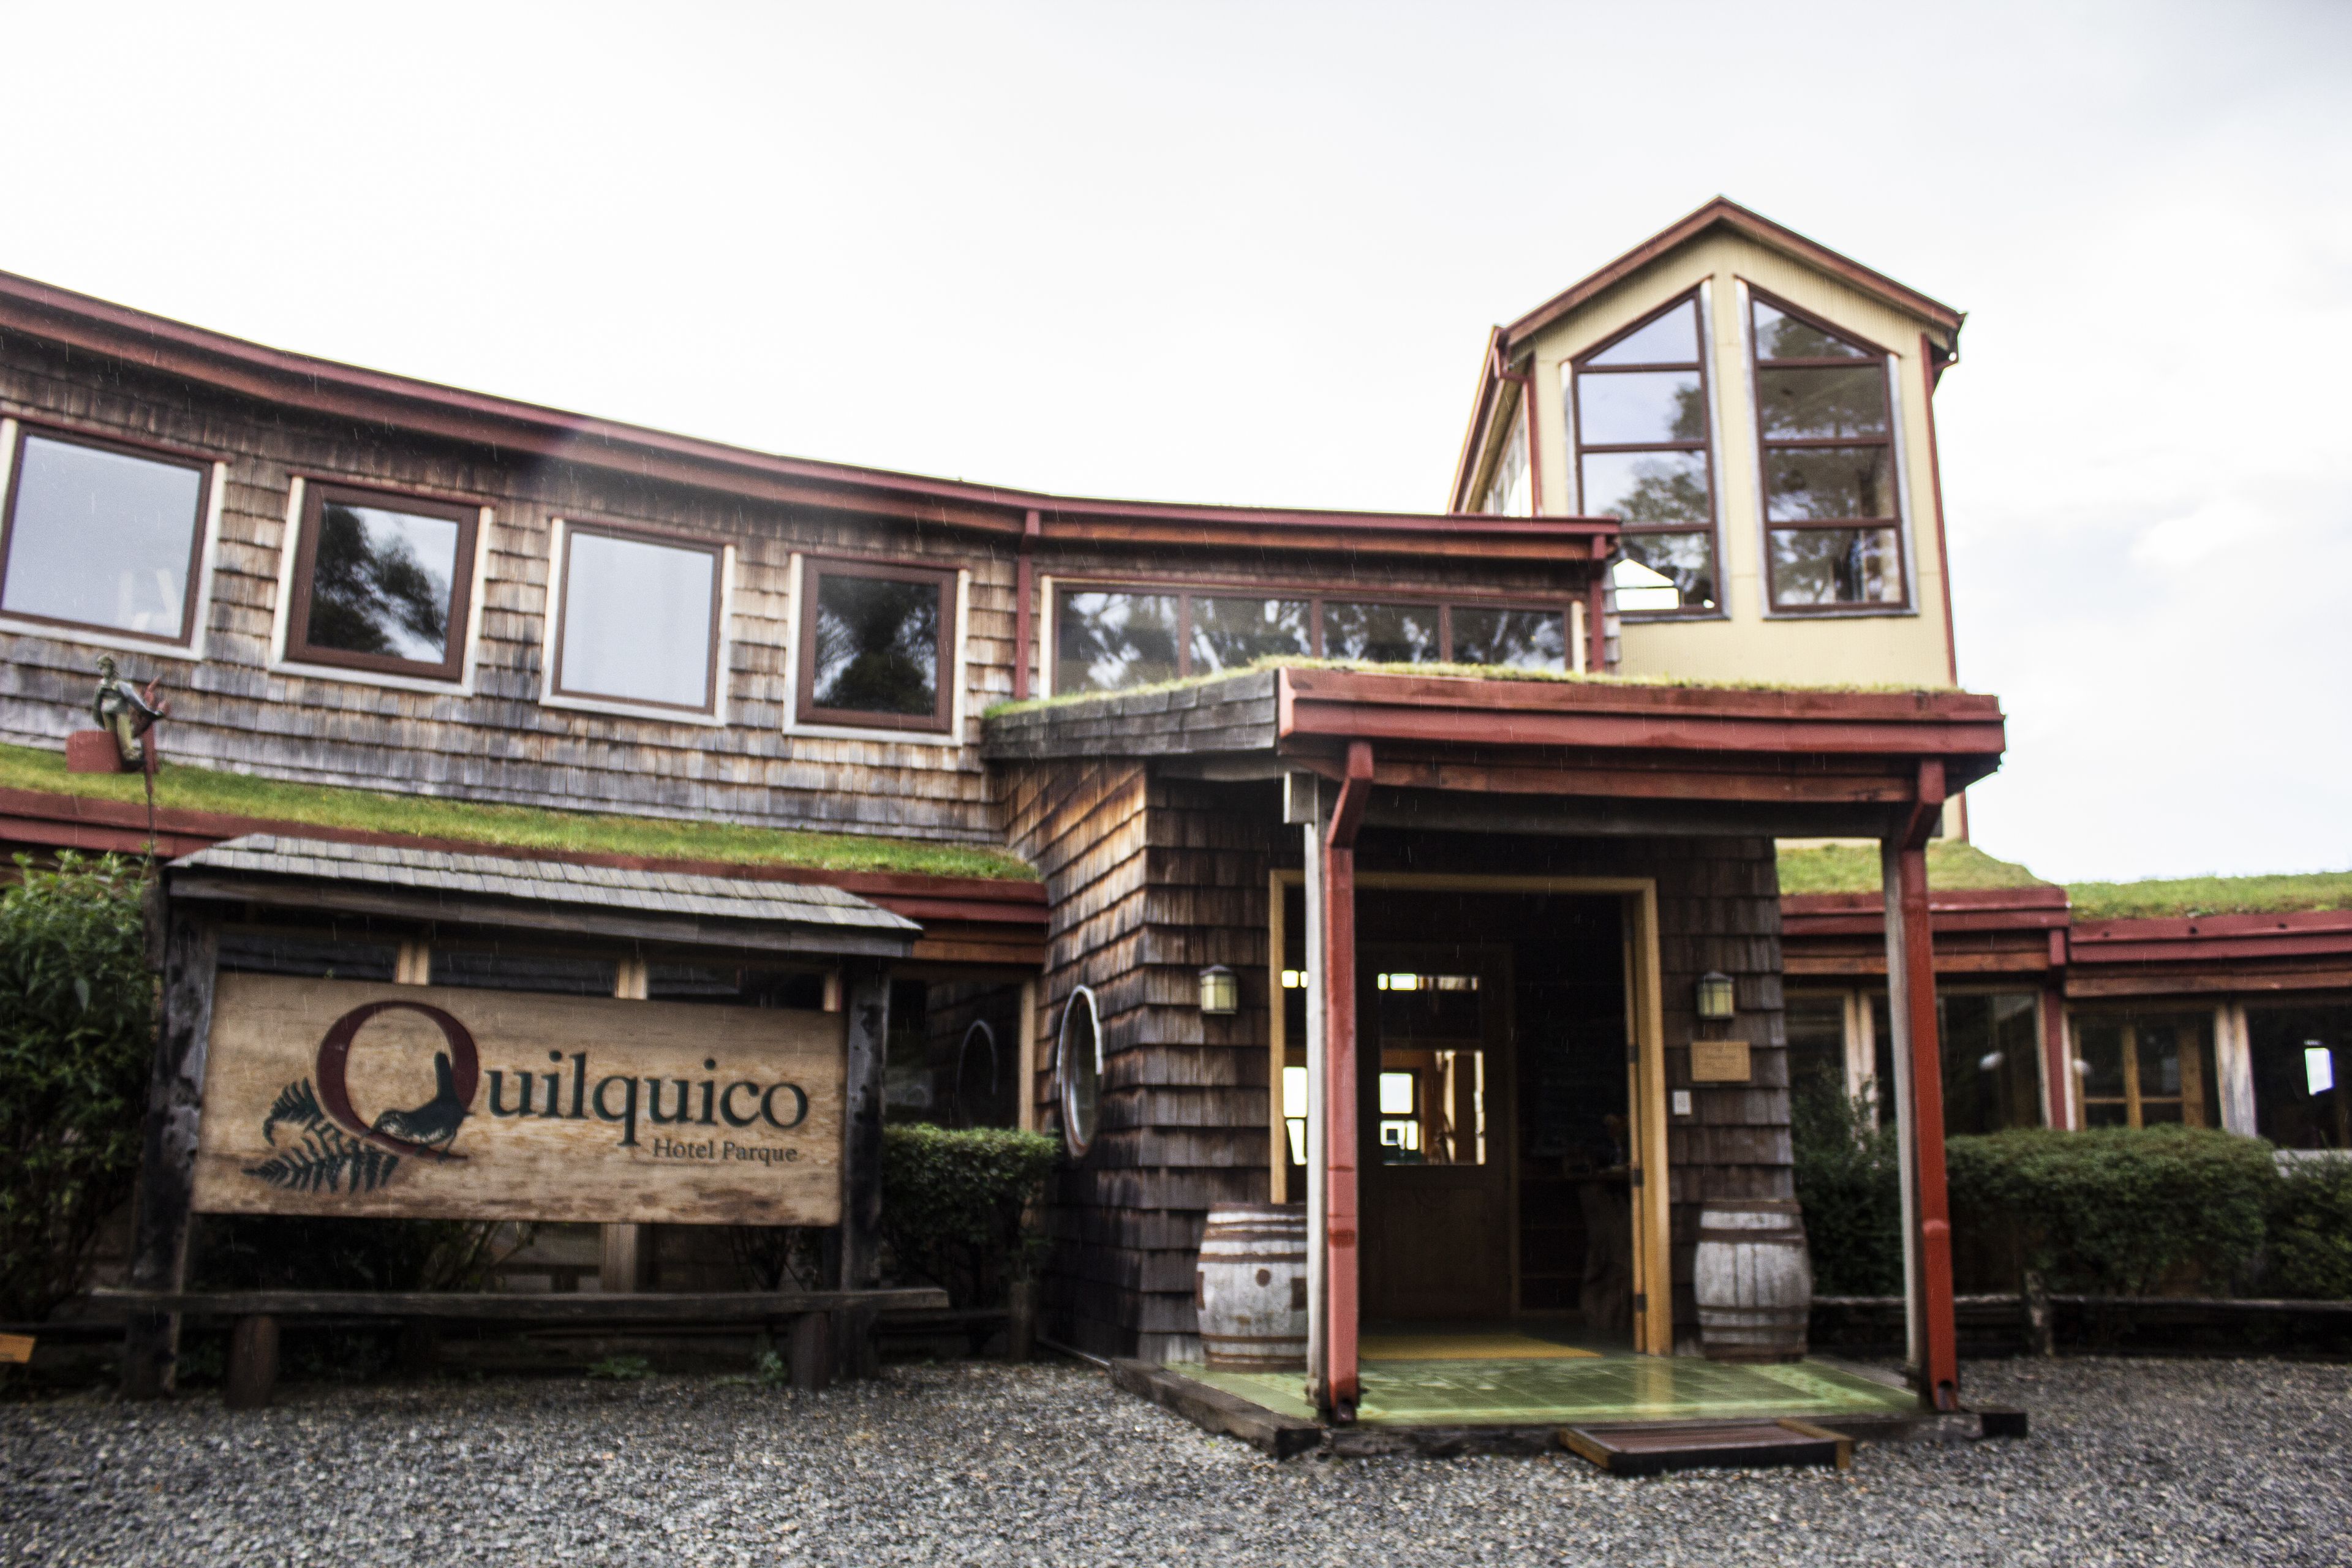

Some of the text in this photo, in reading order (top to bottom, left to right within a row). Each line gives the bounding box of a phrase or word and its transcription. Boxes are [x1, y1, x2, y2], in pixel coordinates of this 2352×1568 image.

[315, 1000, 808, 1159] Quilquico
[653, 1137, 797, 1167] Hotel Parque
